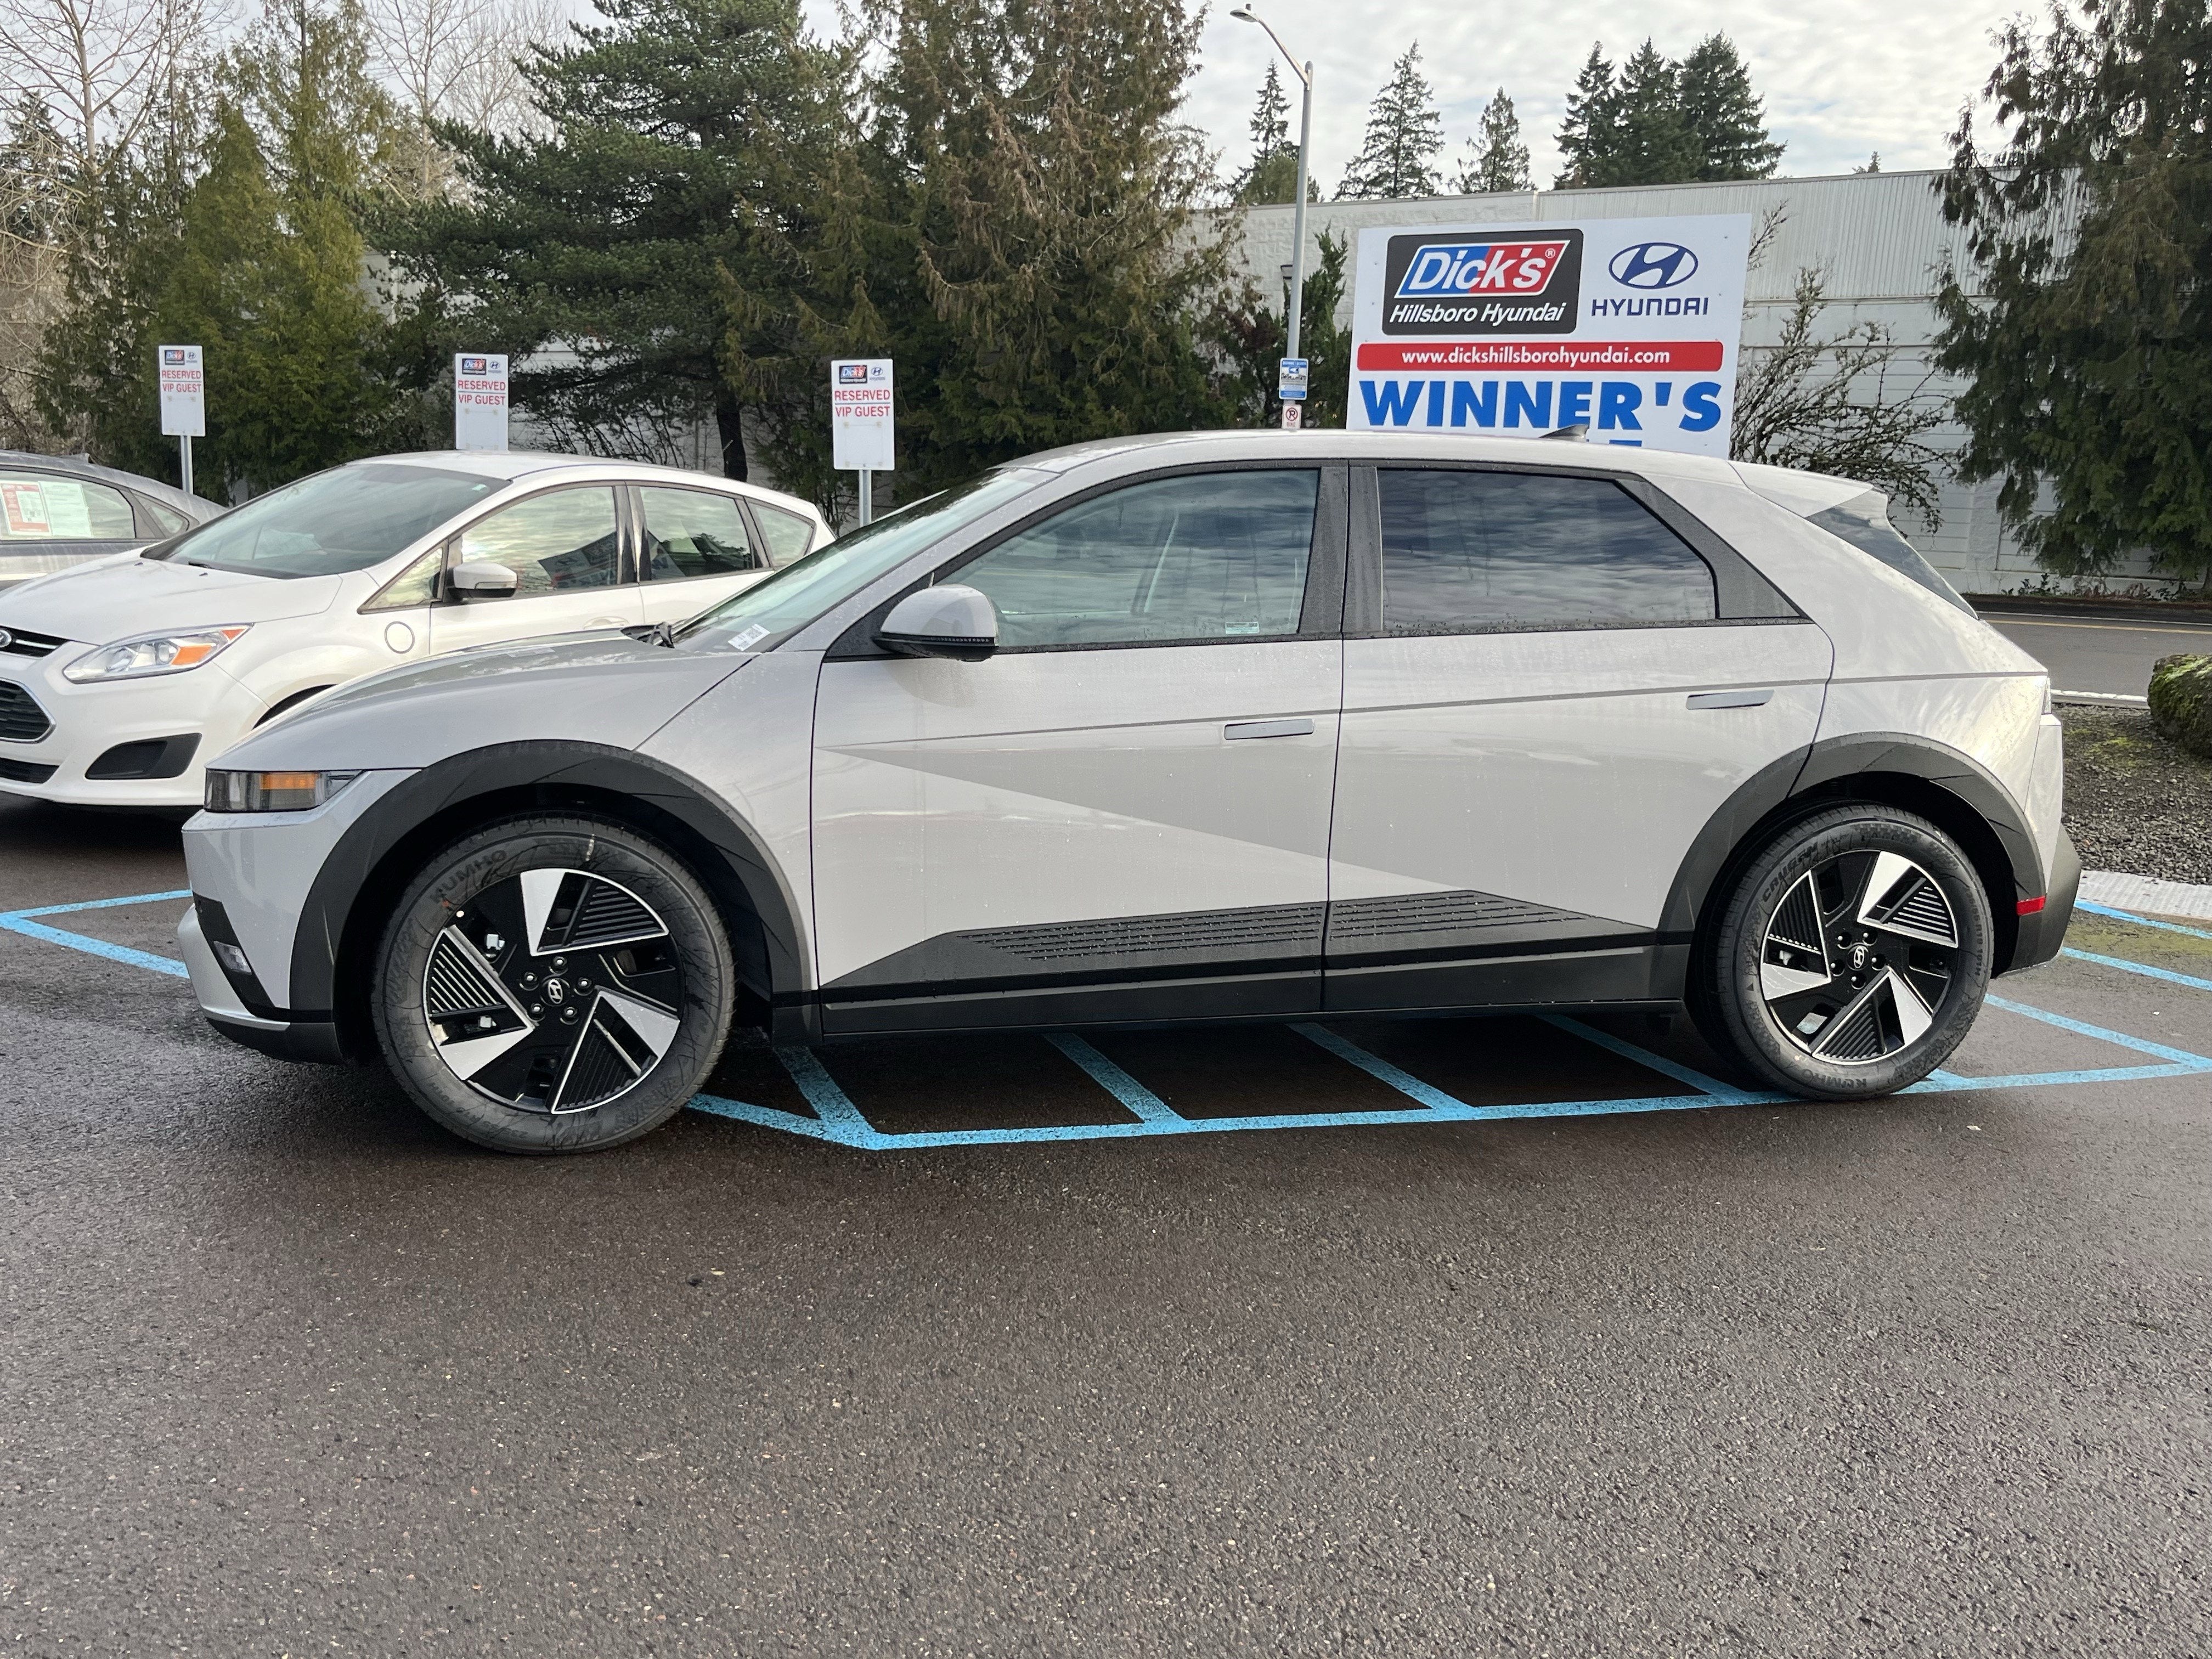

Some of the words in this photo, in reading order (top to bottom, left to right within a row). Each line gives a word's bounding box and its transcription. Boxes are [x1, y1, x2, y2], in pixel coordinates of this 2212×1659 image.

[1592, 297, 1708, 316] HYUNDAI
[1389, 304, 1478, 323] Hillsboro
[1480, 302, 1567, 326] Hyundai
[1402, 346, 1670, 368] www.dickshillsborohyundai.com
[161, 370, 201, 379] RESERVED
[162, 383, 174, 392] VIP
[176, 384, 201, 392] GUEST
[458, 380, 506, 391] RESERVED
[459, 394, 472, 403] VIP
[475, 395, 505, 405] GUEST
[834, 390, 890, 401] RESERVED
[835, 407, 851, 417] VIP
[855, 406, 890, 417] GUEST
[1359, 381, 1722, 432] WINNER'S
[431, 850, 506, 904] KUMHO
